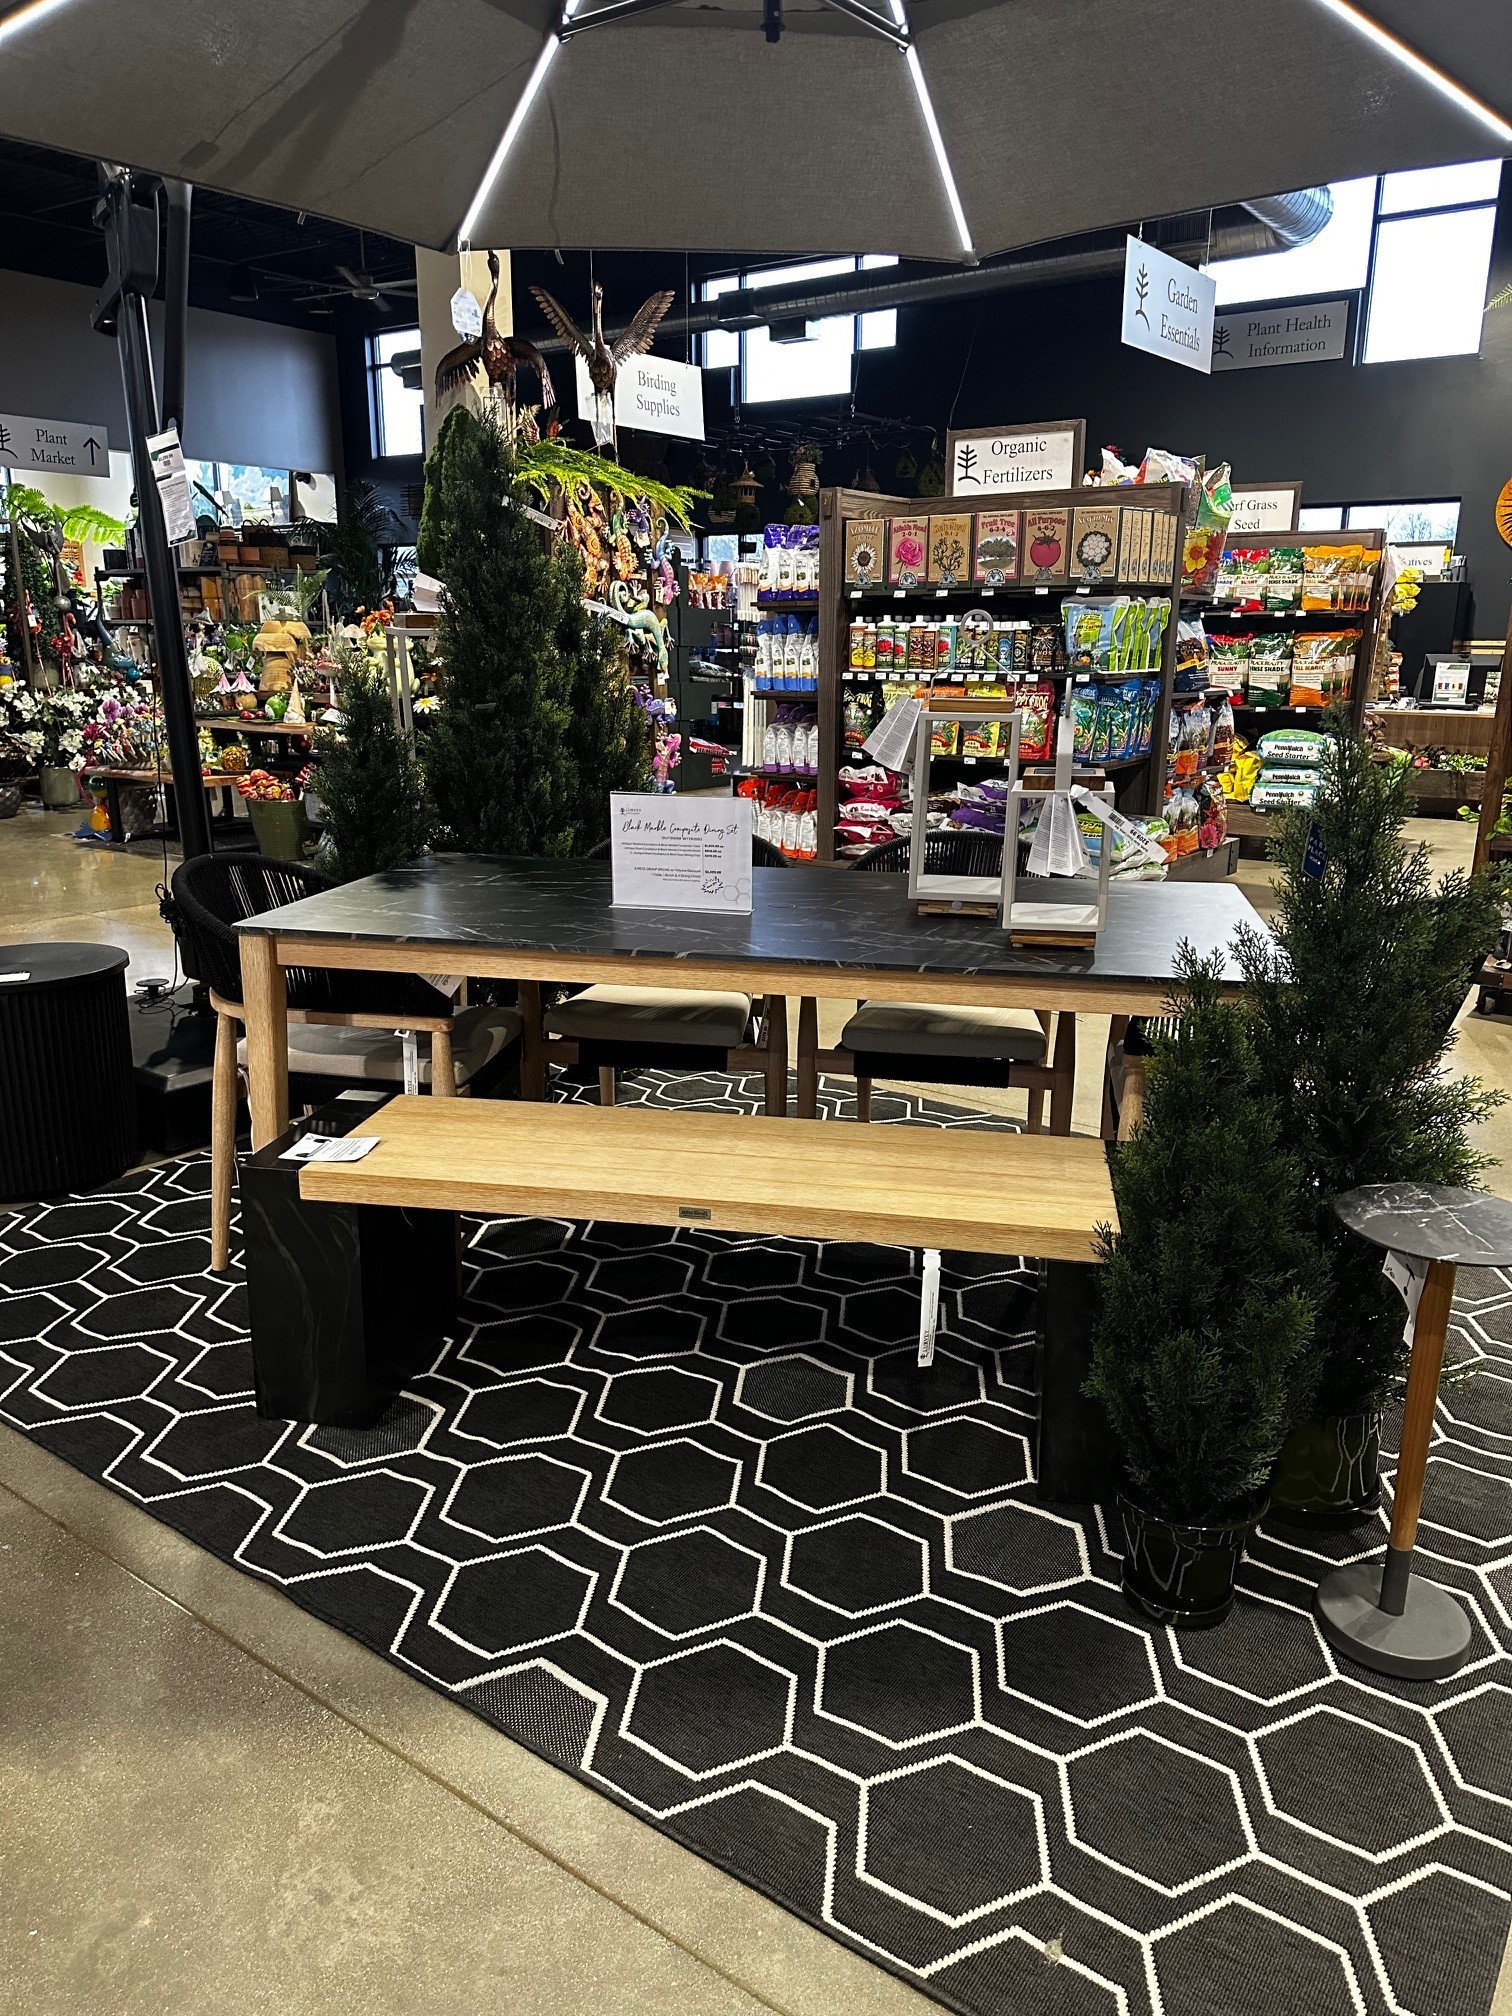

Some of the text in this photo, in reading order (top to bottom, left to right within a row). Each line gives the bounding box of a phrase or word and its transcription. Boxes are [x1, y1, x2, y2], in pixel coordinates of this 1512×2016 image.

[1168, 278, 1198, 314] Garden
[1161, 314, 1200, 351] Essentials
[1247, 314, 1331, 337] Plant Health
[1248, 339, 1326, 357] Information
[638, 371, 676, 396] Birding
[636, 394, 680, 417] Supplies
[36, 429, 68, 445] Plant
[991, 437, 1047, 458] Organic
[30, 448, 75, 465] Market
[983, 467, 1053, 484] Fertilizers
[1247, 500, 1278, 510] Grass
[981, 518, 1015, 529] Fruit Tree
[1028, 516, 1066, 527] All Purpose
[1234, 519, 1260, 530] Seed
[622, 819, 739, 840] Black Marble Composite Dining Set
[1310, 837, 1325, 850] PAR
